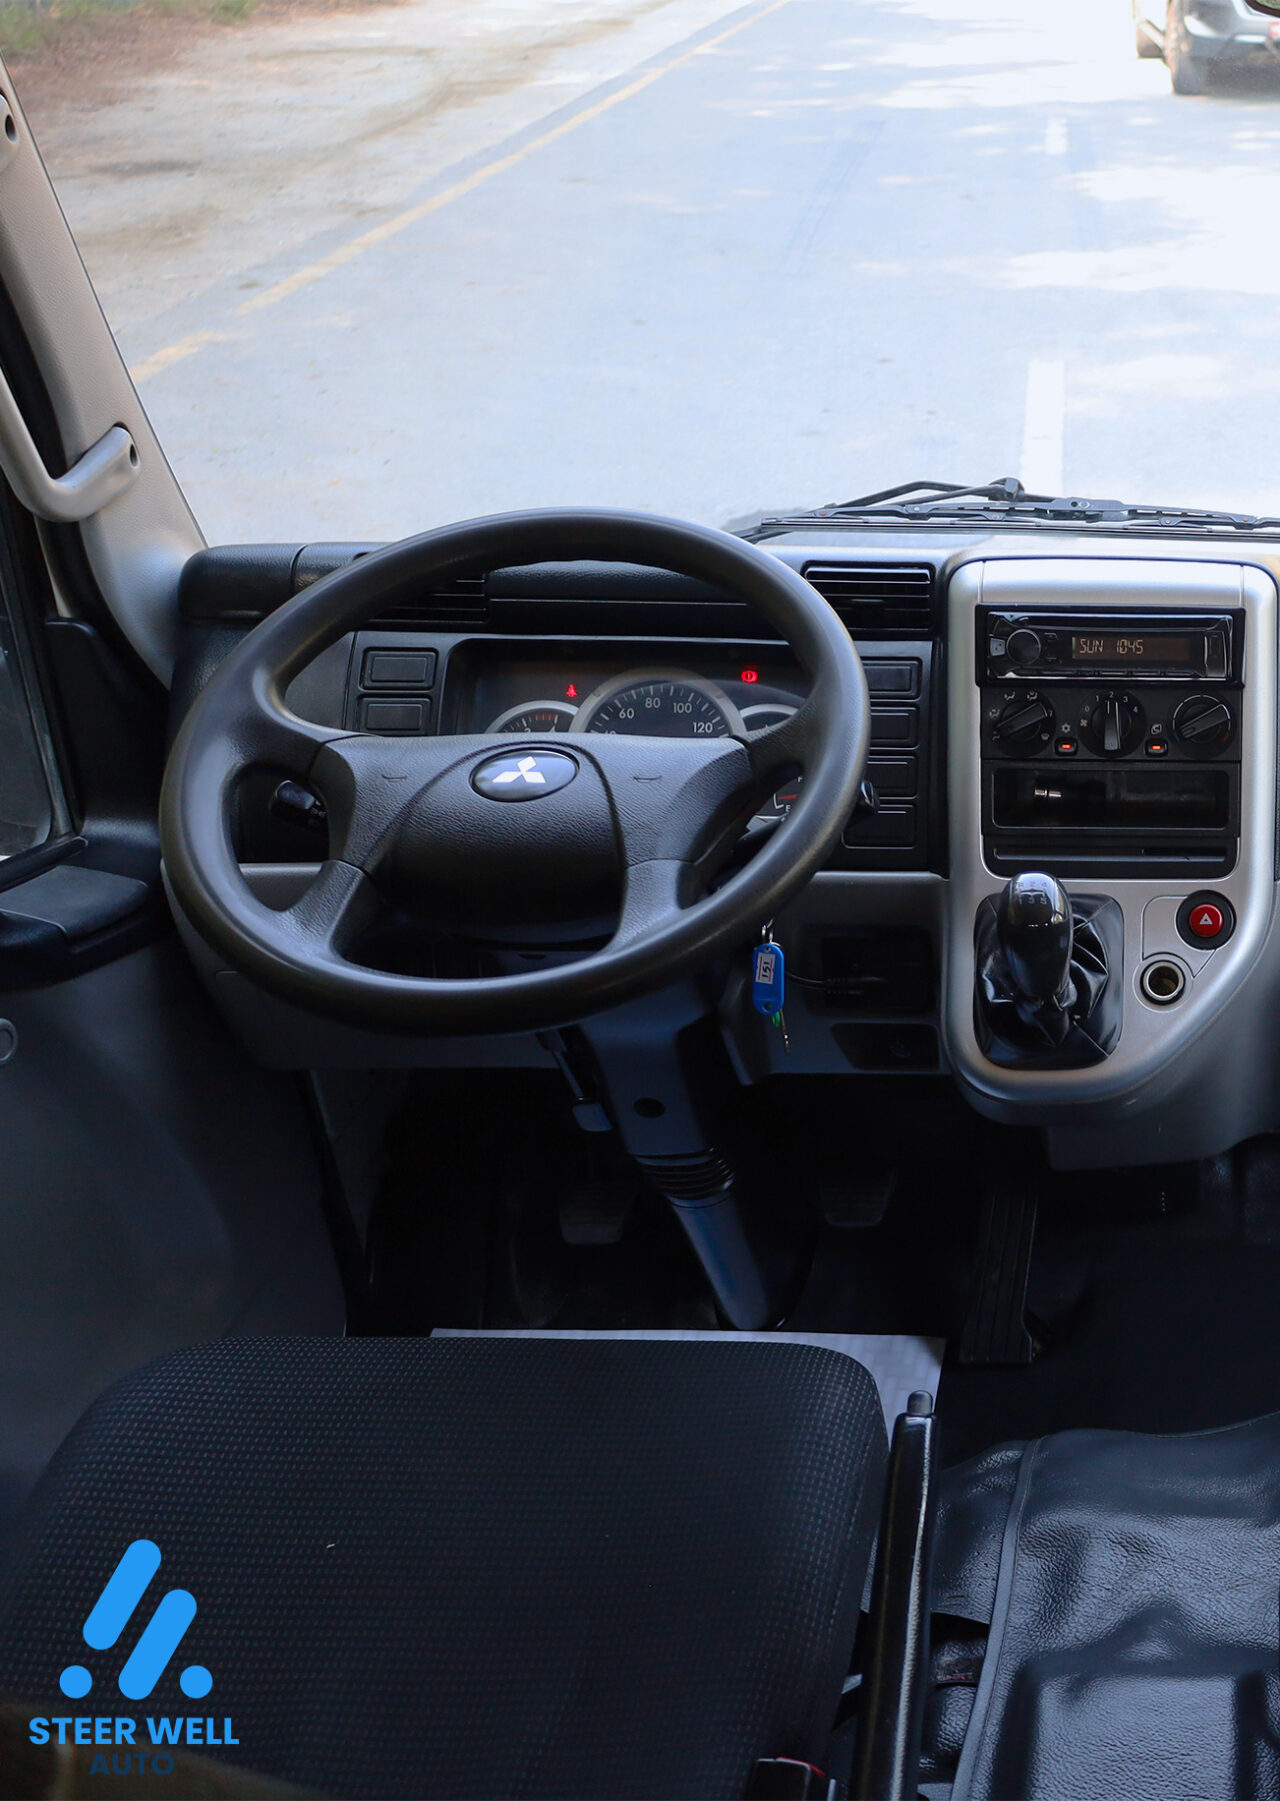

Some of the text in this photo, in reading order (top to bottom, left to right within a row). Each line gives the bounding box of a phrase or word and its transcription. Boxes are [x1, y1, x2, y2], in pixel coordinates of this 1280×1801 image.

[1079, 638, 1104, 654] SUN
[644, 697, 661, 708] 80
[1123, 695, 1128, 703] 3
[673, 702, 692, 713] 100
[618, 708, 635, 719] 60
[693, 722, 713, 733] 120
[785, 804, 791, 812] E
